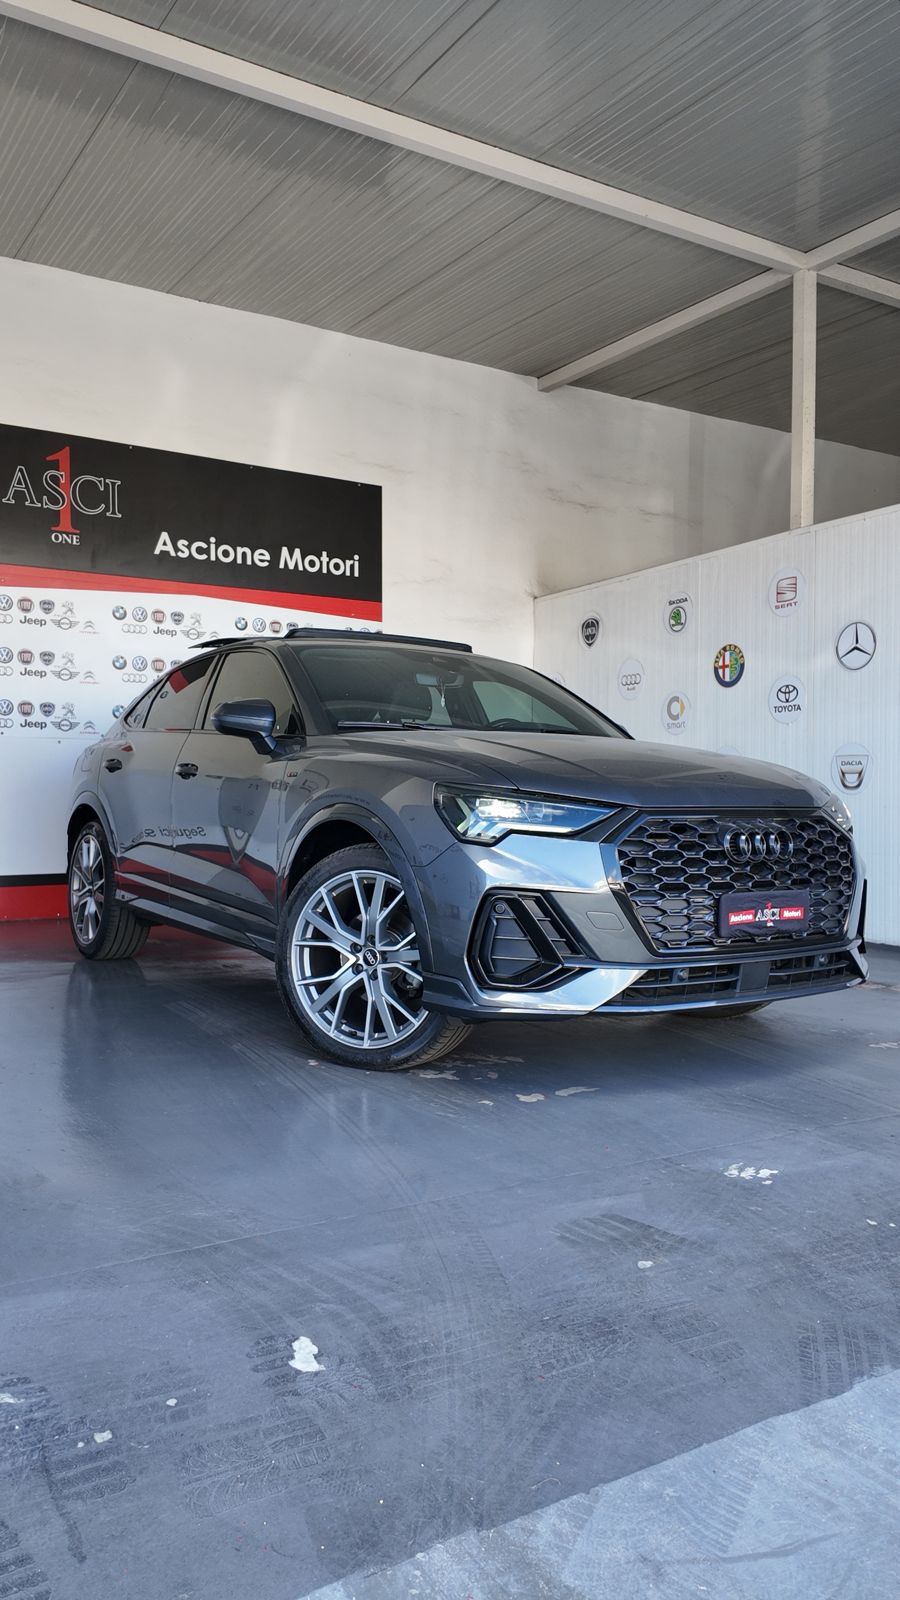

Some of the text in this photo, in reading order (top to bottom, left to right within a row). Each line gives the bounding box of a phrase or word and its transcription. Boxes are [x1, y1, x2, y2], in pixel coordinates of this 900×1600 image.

[2, 466, 121, 518] ASCI
[51, 532, 80, 546] ONE
[154, 531, 360, 577] Ascione Motori
[775, 601, 798, 610] SEAT
[20, 615, 47, 627] Jeep
[153, 626, 177, 637] Jeep
[20, 667, 47, 679] Jeep
[774, 704, 801, 714] TOYOTA
[20, 719, 47, 730] Jeep
[667, 721, 686, 729] smart
[756, 908, 780, 921] ASCI
